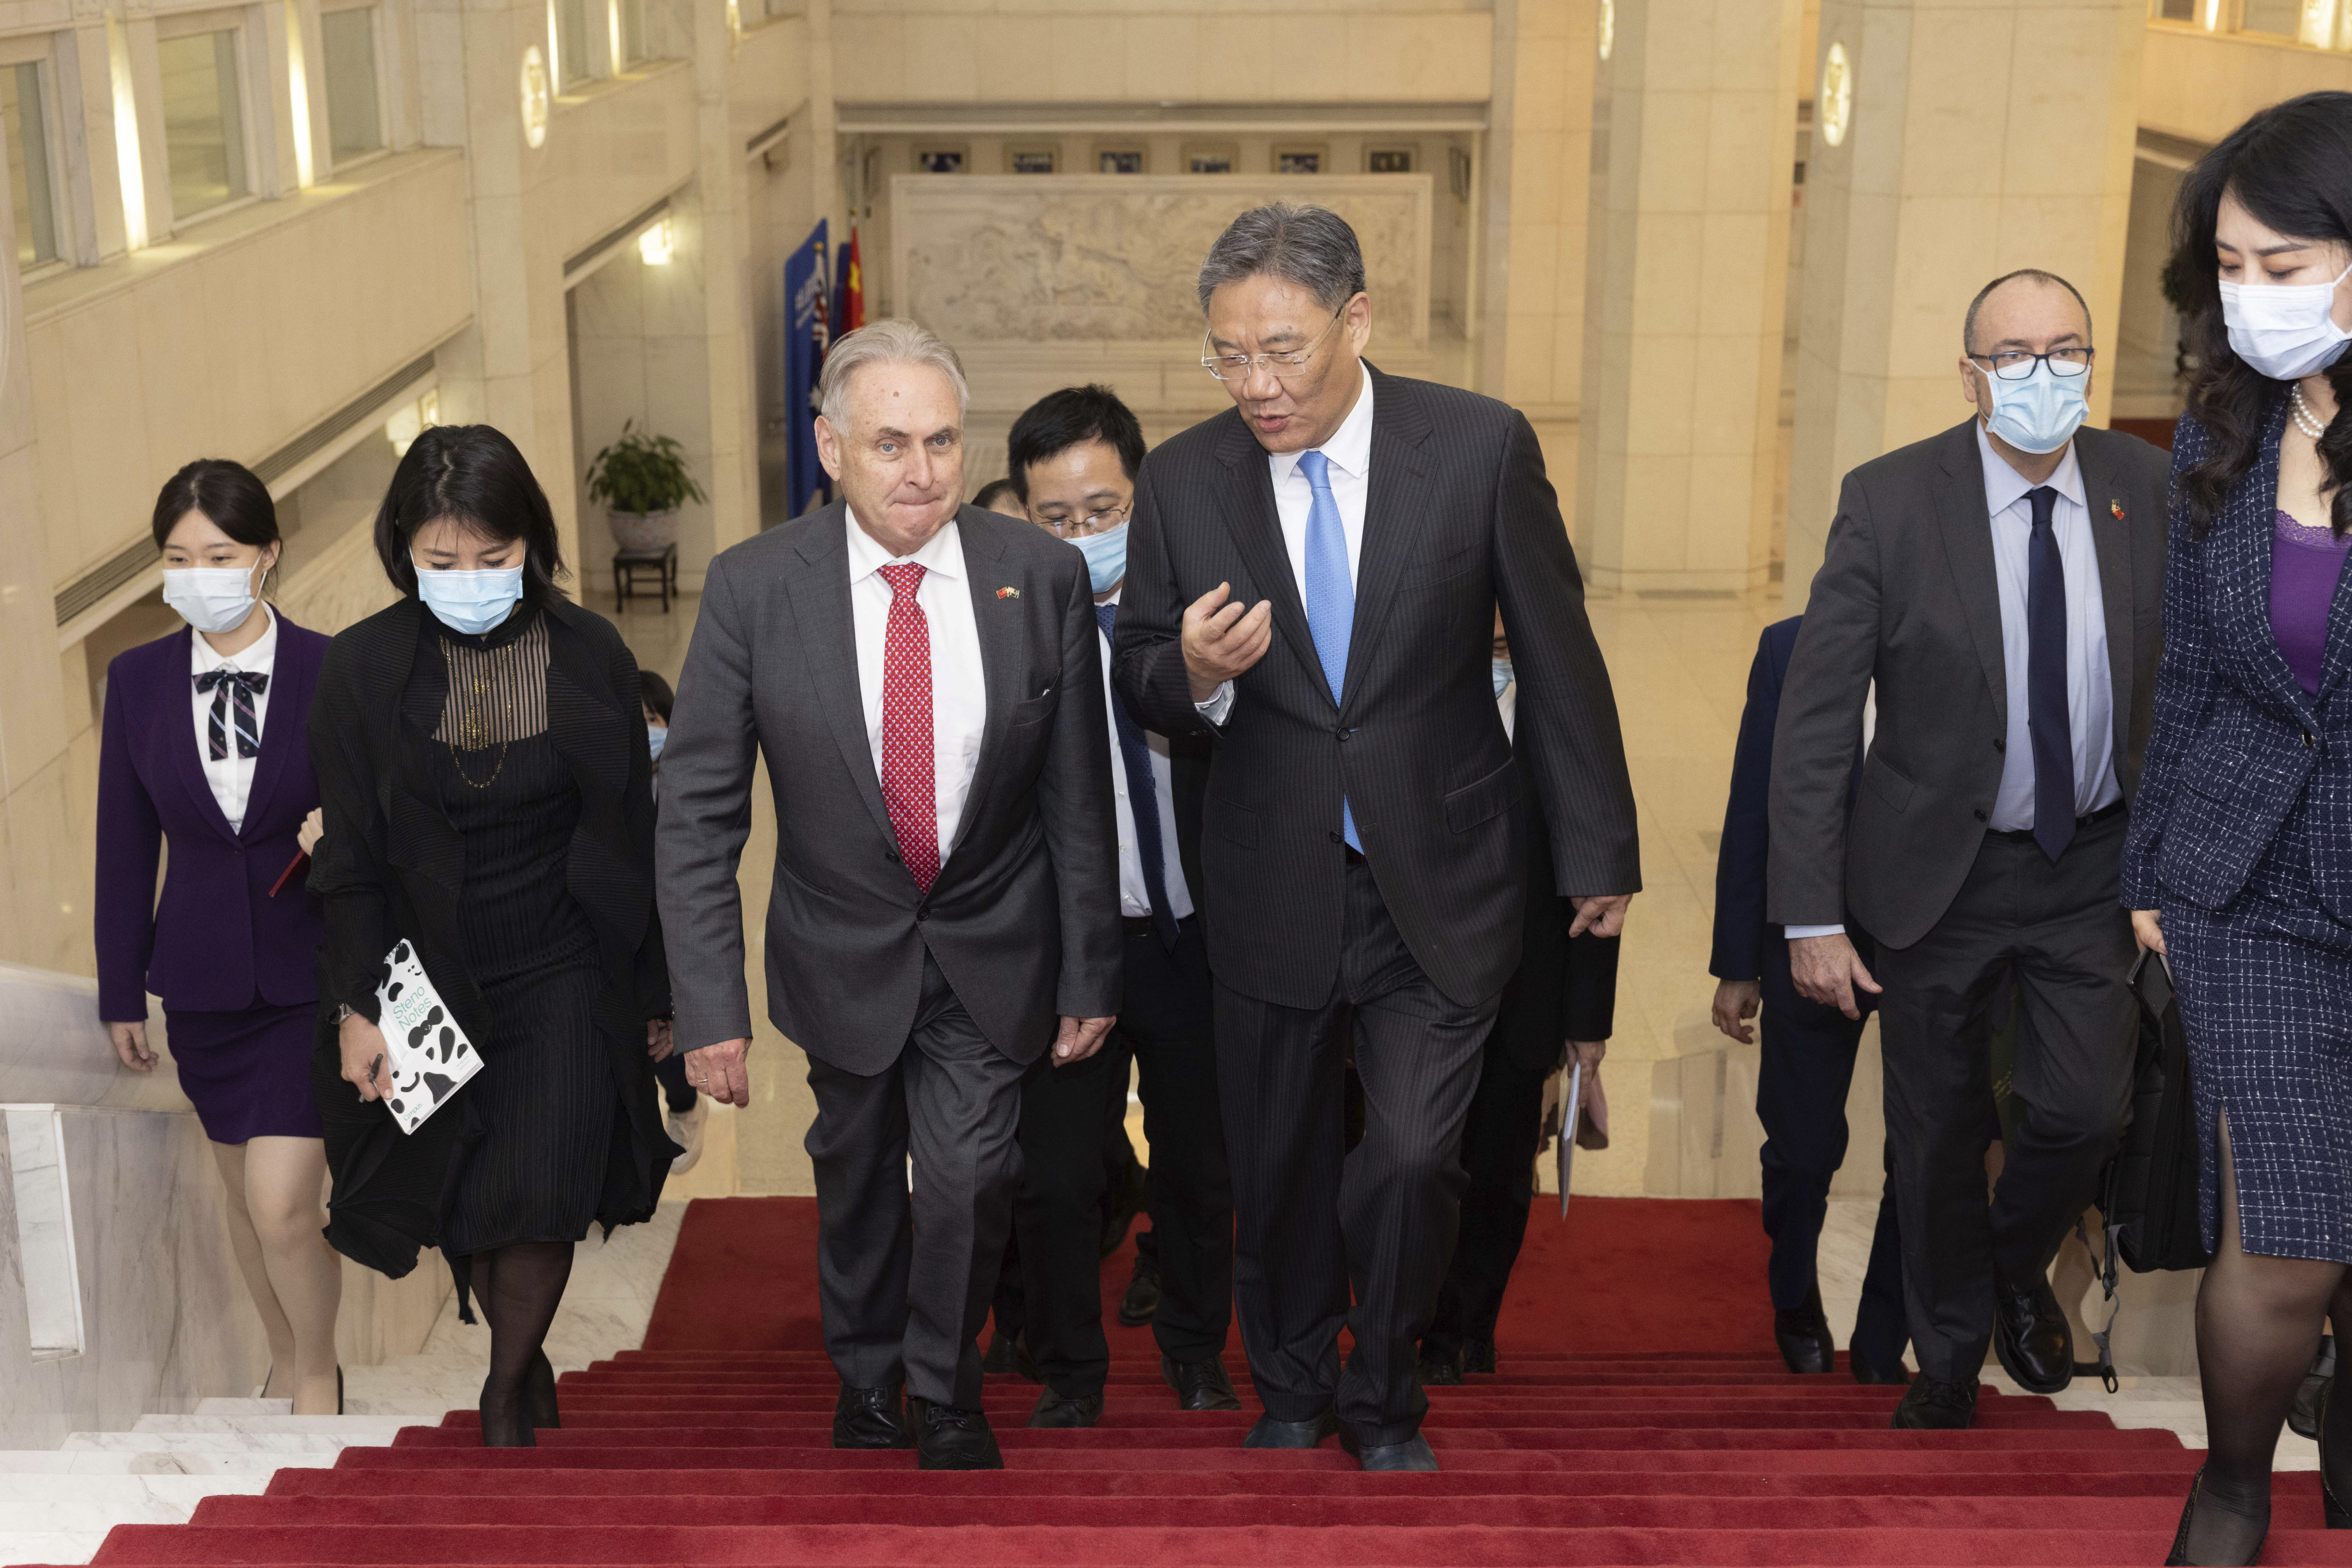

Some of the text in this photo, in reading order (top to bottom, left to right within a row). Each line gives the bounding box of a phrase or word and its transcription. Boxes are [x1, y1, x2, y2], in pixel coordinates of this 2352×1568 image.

[393, 986, 424, 1019] Steno
[399, 998, 432, 1032] Notes
[404, 1102, 423, 1121] Campus
